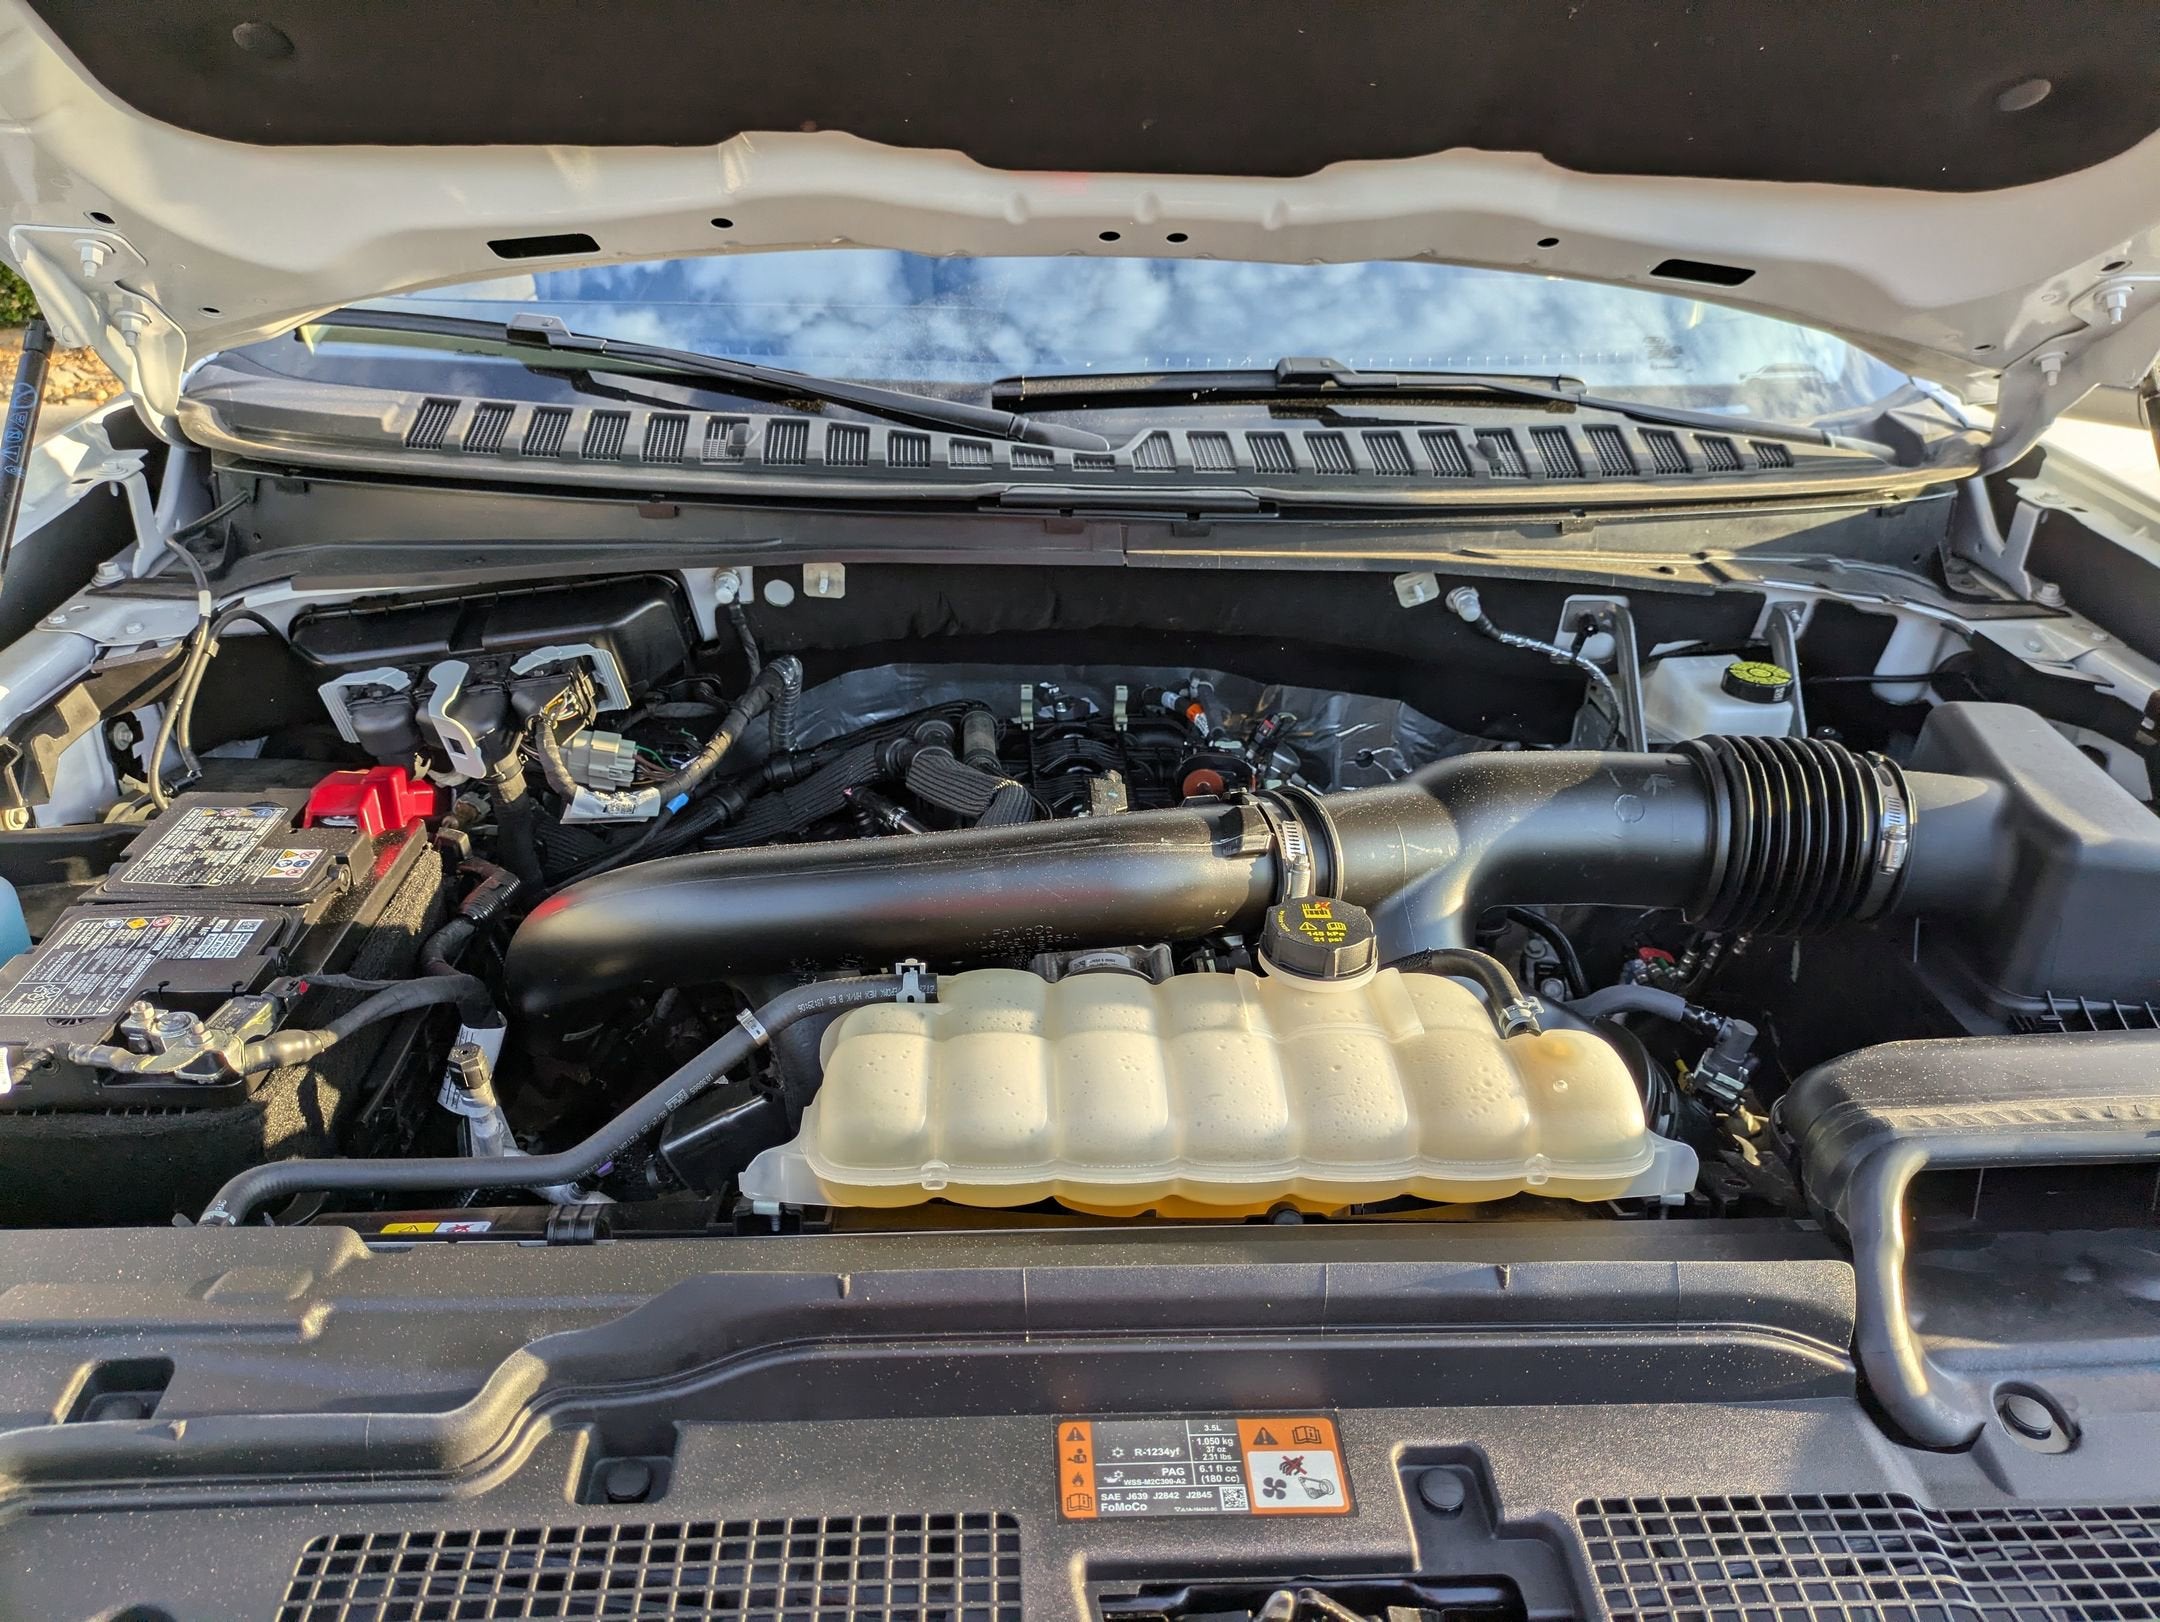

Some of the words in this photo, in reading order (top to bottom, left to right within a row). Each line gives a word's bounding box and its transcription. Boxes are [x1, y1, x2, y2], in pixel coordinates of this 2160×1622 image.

[1196, 1437, 1220, 1445] 1.050
[1222, 1437, 1233, 1446] kg
[1134, 1447, 1180, 1457] R-1234yf
[1161, 1467, 1185, 1476] PAG
[1216, 1464, 1223, 1472] fl
[1201, 1475, 1222, 1484] (180
[1225, 1474, 1240, 1483] cc)
[1101, 1493, 1121, 1501] SAE
[1126, 1492, 1148, 1500] J639
[1153, 1491, 1179, 1500] J2842
[1186, 1491, 1213, 1499] J2845
[1101, 1502, 1147, 1512] FoMoCo
